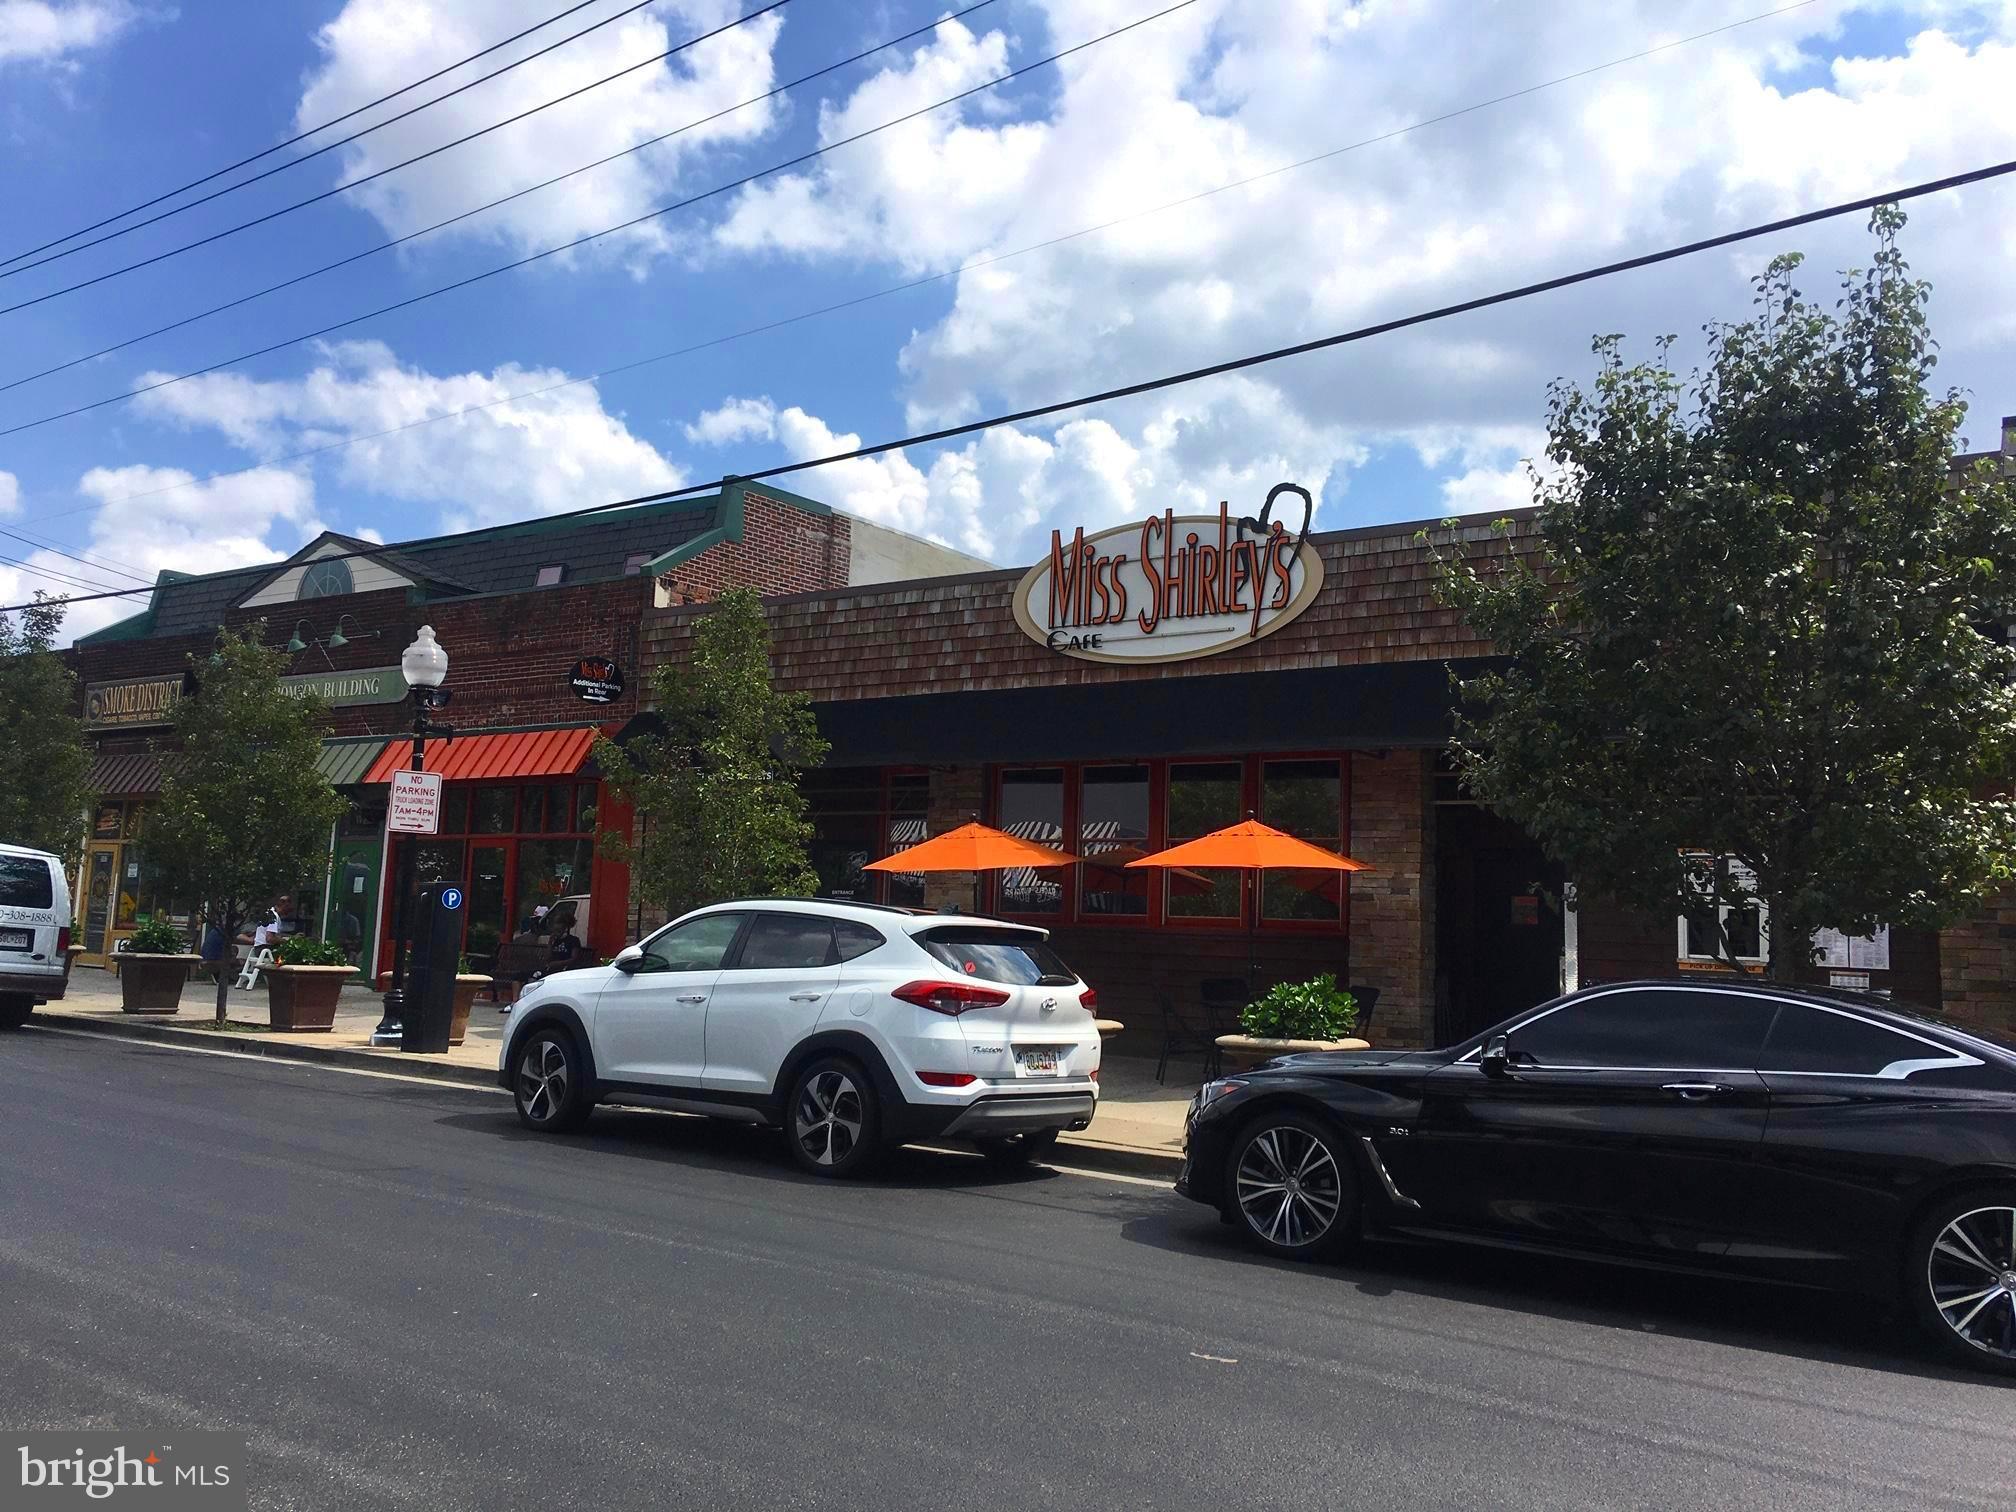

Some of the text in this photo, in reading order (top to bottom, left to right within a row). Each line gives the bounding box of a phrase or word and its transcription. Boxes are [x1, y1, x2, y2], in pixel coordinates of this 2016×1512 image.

[1047, 630, 1103, 652] CAFE
[324, 678, 380, 698] BUILDING
[573, 679, 621, 692] Additional Parking
[103, 680, 183, 715] SMOKE DISTRICT
[410, 776, 423, 784] NO
[395, 785, 436, 797] PARKING
[394, 805, 434, 816] 7AM-4PM
[449, 892, 457, 906] P
